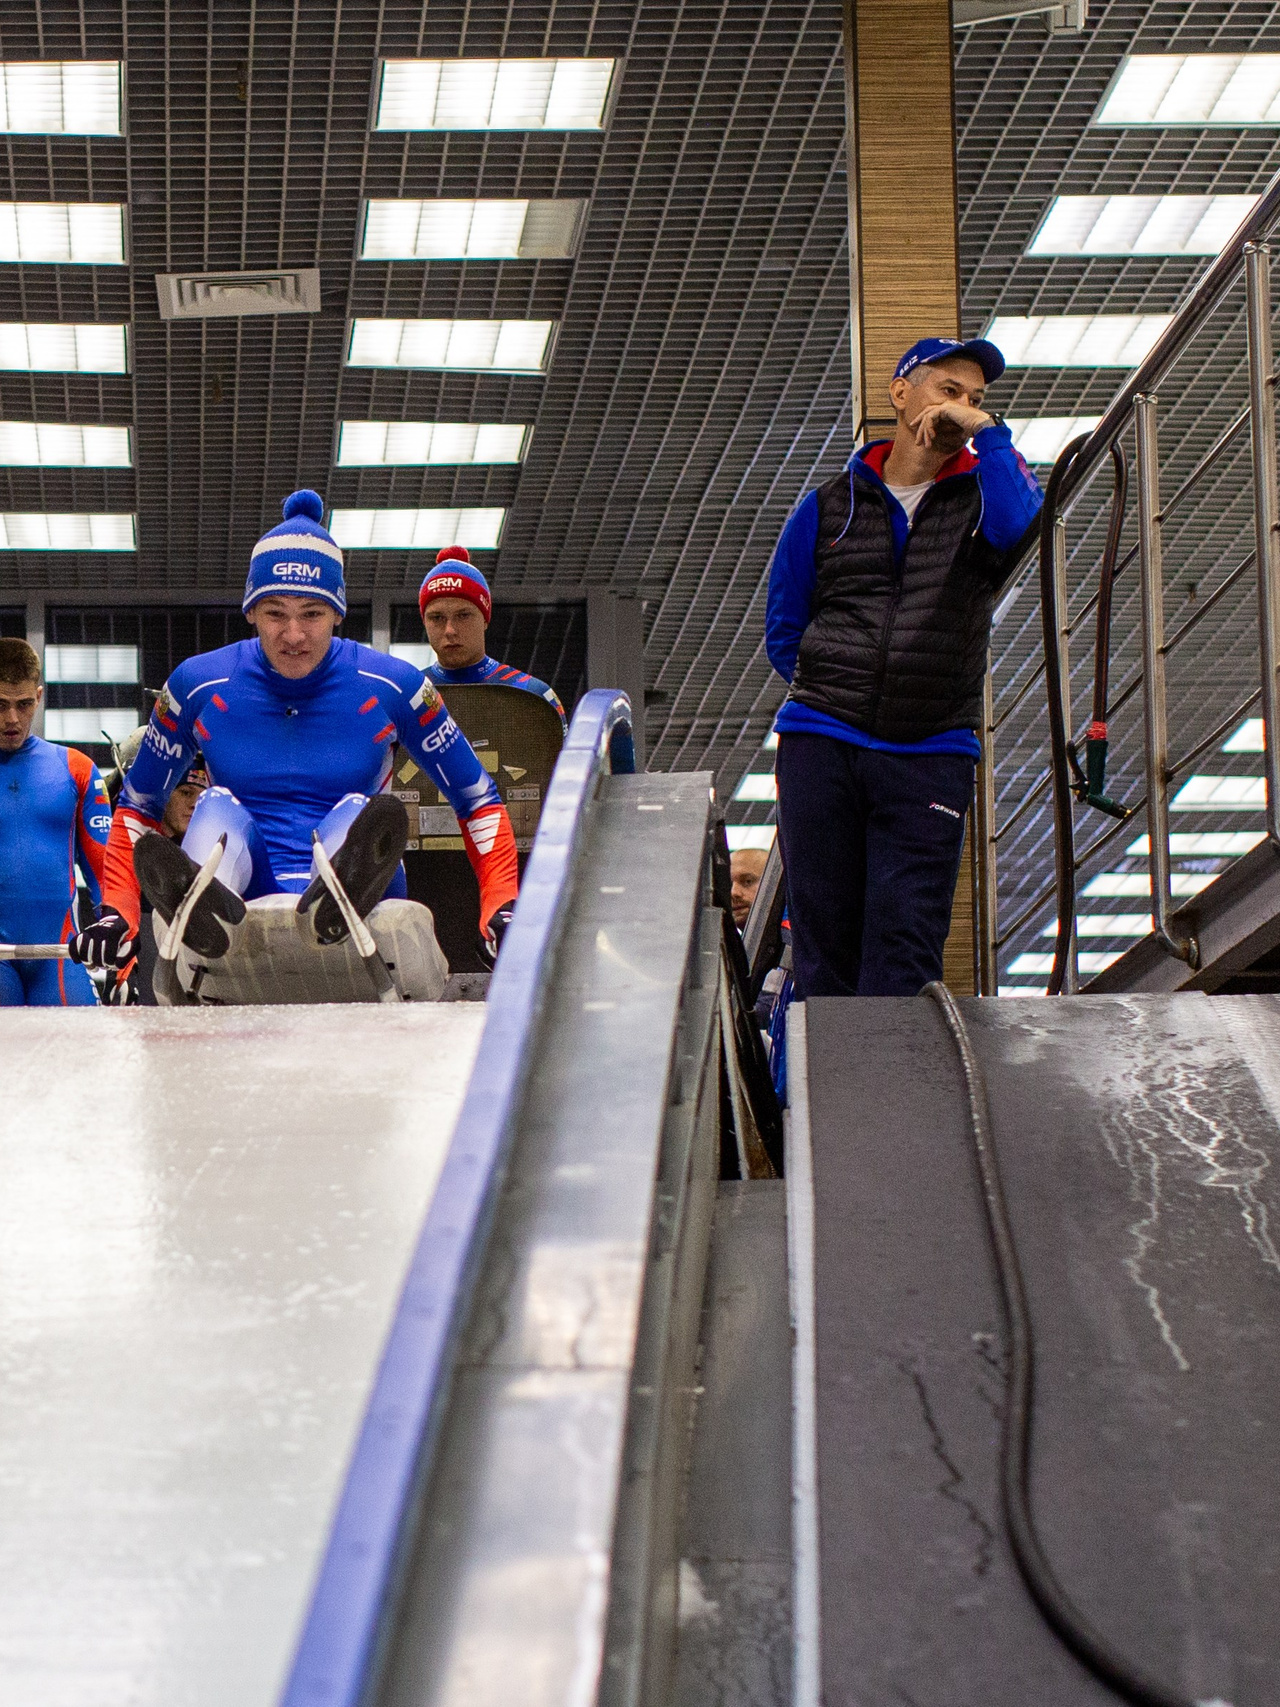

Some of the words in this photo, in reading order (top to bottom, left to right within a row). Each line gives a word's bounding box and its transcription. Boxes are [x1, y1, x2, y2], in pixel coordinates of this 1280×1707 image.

[272, 562, 320, 579] GRM
[428, 577, 463, 591] GRM
[89, 815, 113, 828] GR
